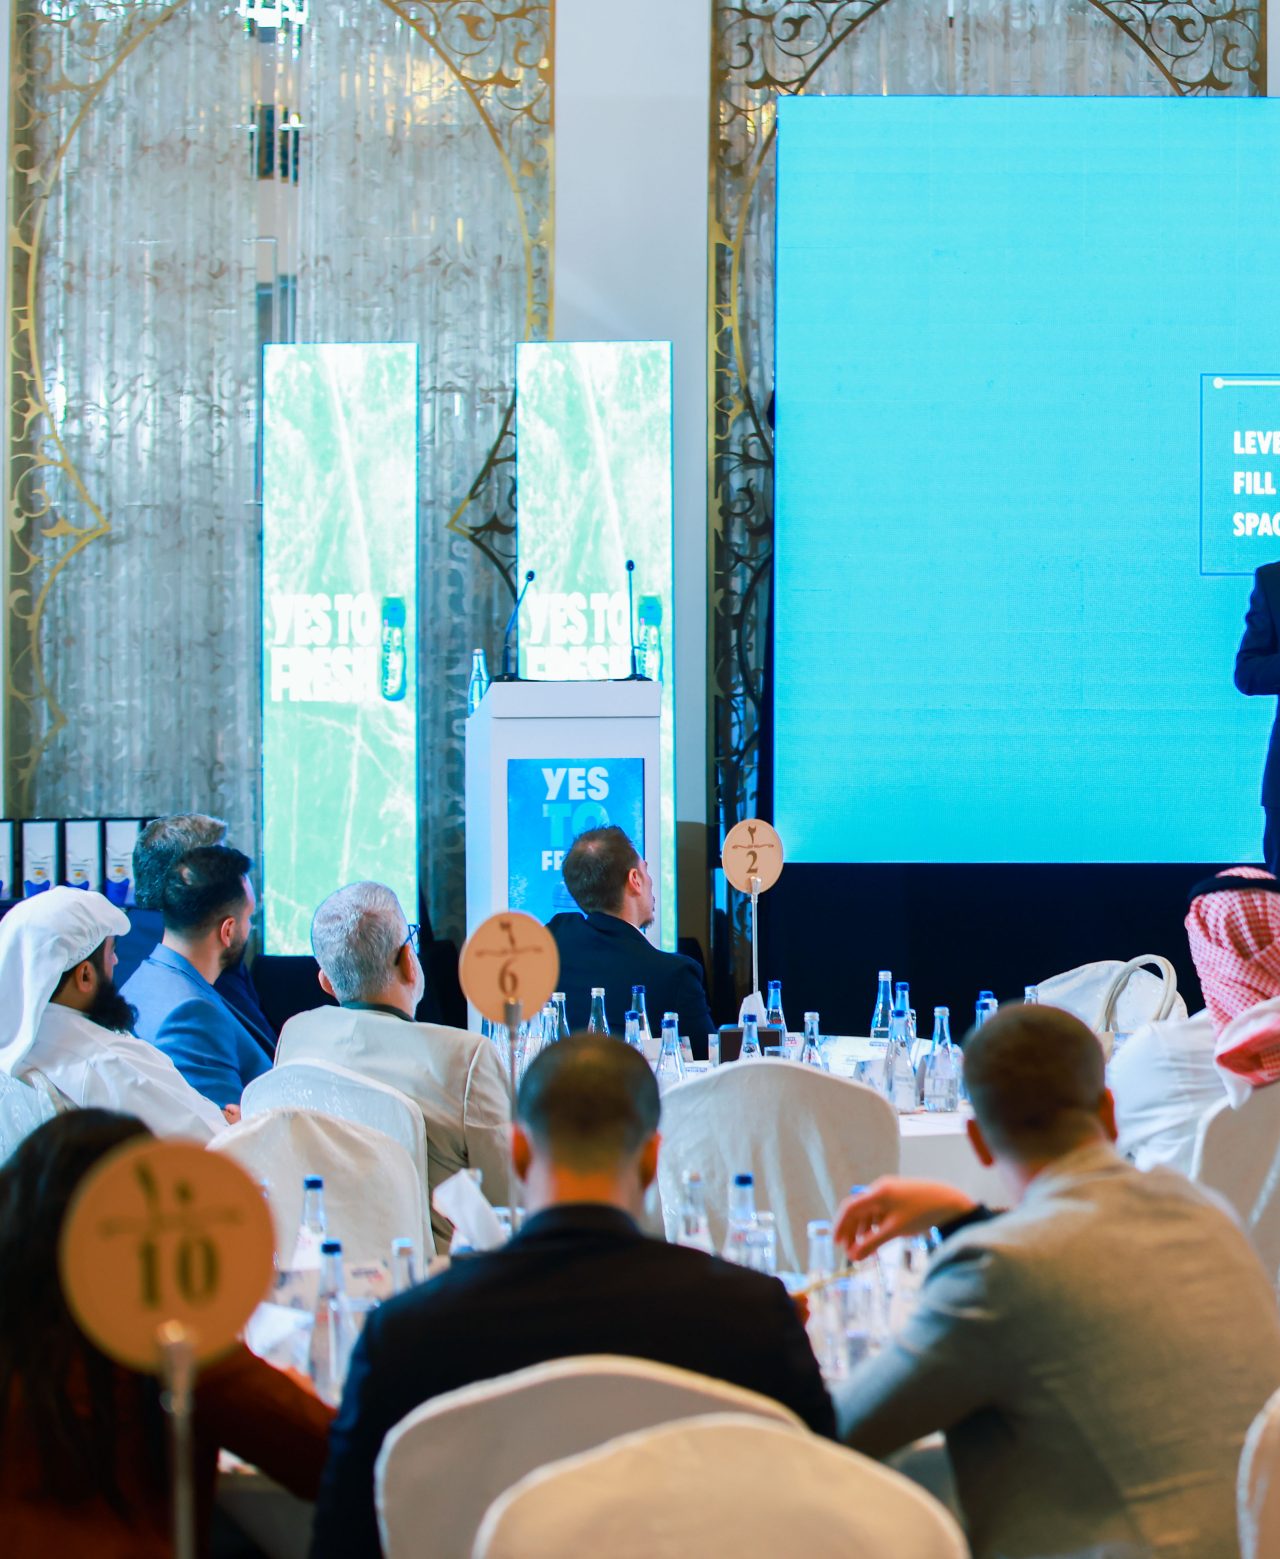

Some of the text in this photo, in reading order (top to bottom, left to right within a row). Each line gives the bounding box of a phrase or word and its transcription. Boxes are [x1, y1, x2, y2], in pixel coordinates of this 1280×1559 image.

[1233, 471, 1276, 495] FILL
[271, 593, 377, 645] YES TO
[526, 592, 631, 645] YES TO
[271, 647, 378, 702] FRESH
[541, 767, 609, 800] YES
[542, 802, 609, 847] TO
[746, 850, 758, 873] 2
[498, 959, 518, 998] 6
[138, 1238, 220, 1308] 10
